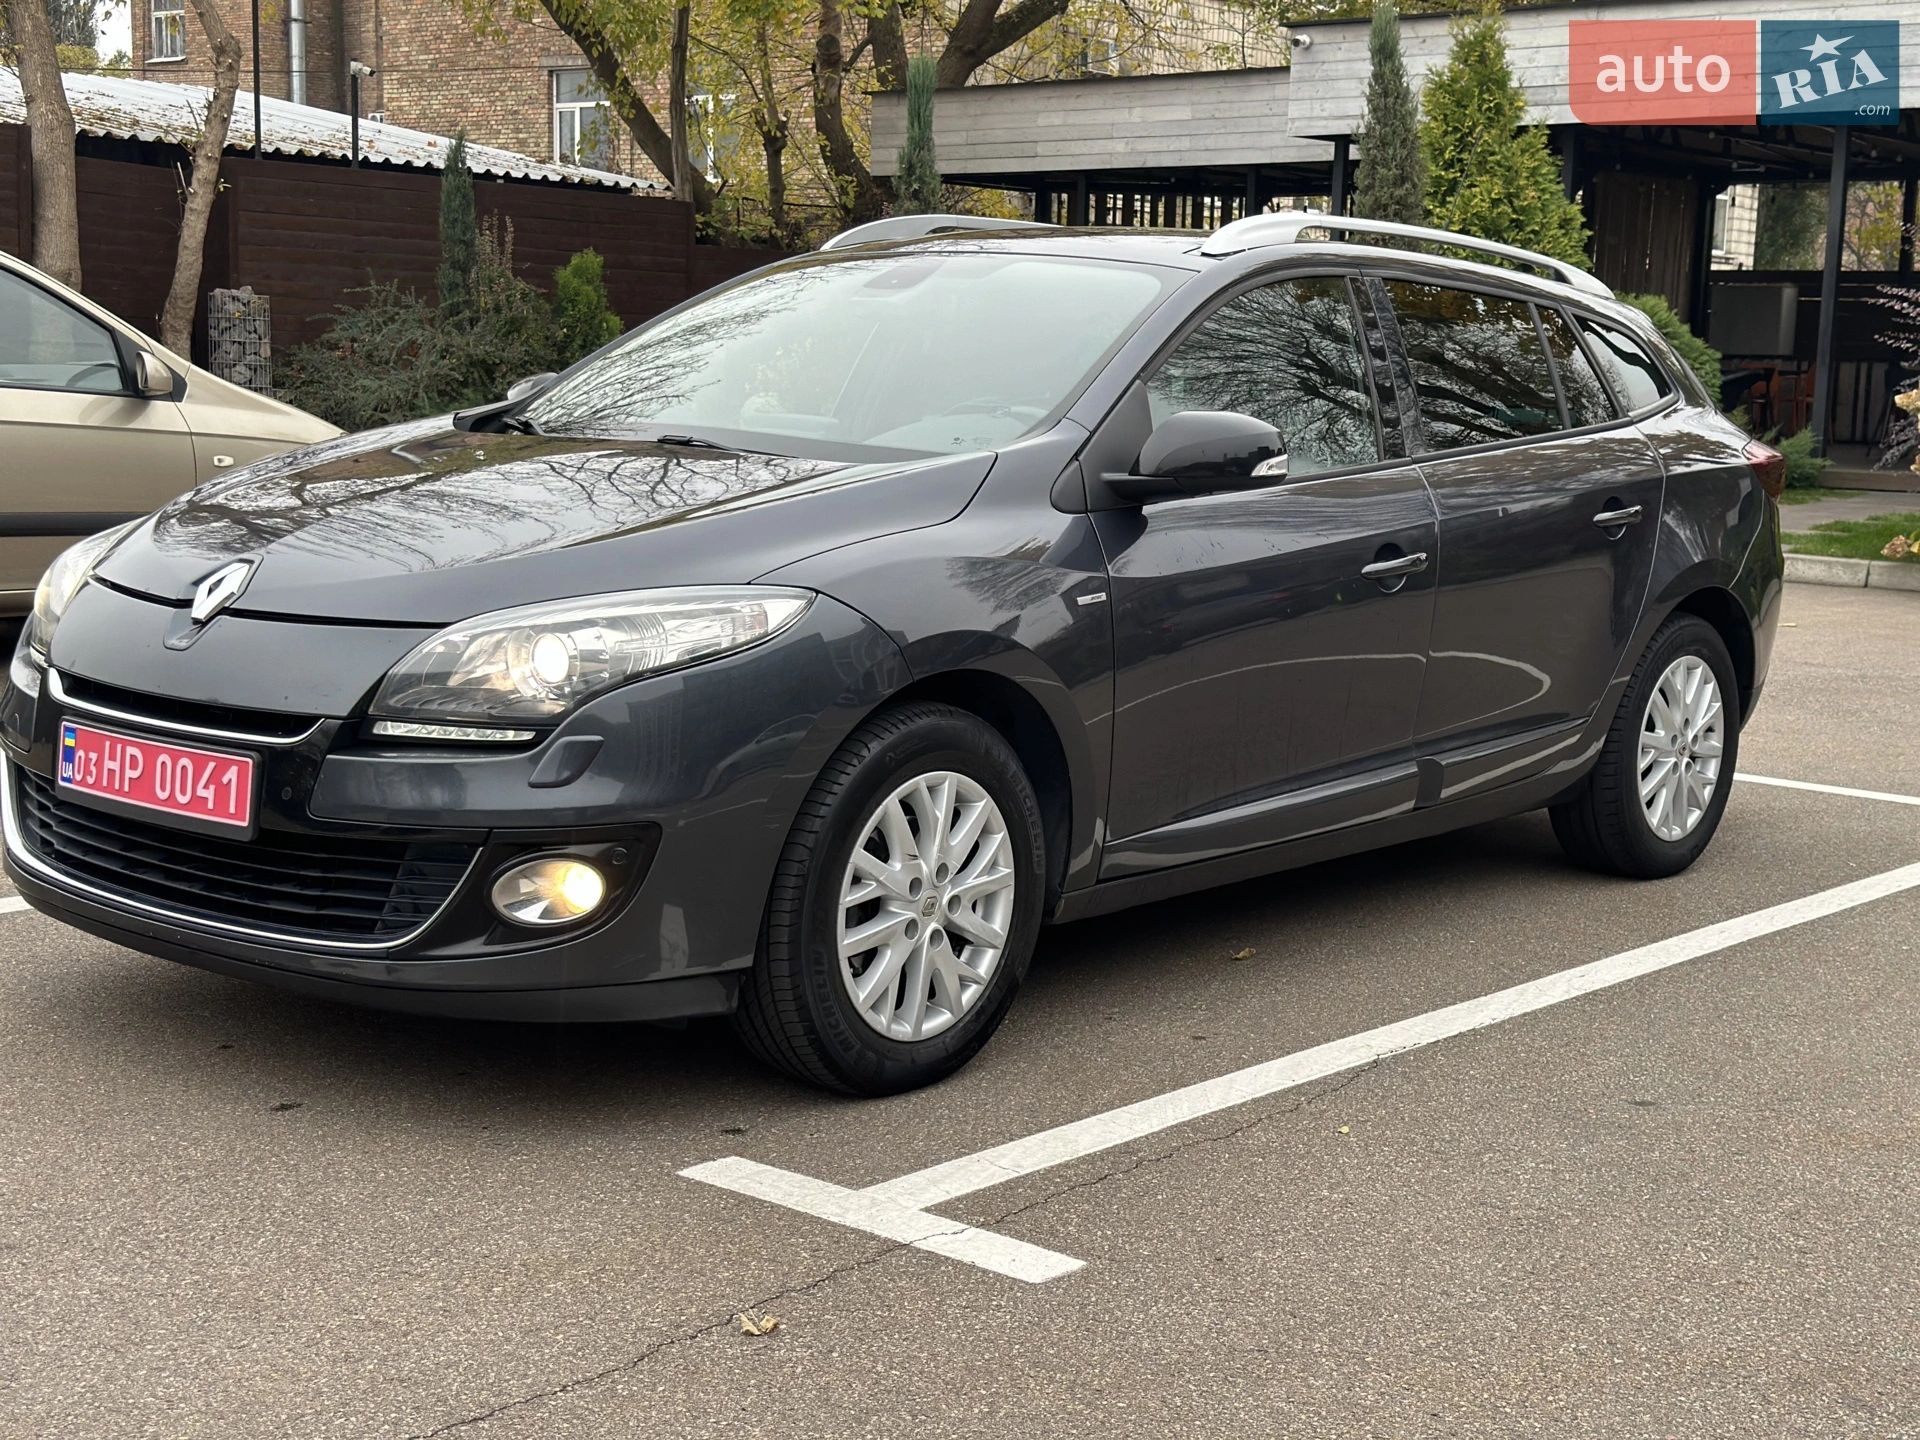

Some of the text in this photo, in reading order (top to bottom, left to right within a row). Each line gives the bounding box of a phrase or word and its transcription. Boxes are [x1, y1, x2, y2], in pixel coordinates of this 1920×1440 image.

[62, 761, 73, 779] UA
[74, 740, 239, 814] 03 HP 0041
[811, 949, 859, 1055] MICHELIN
